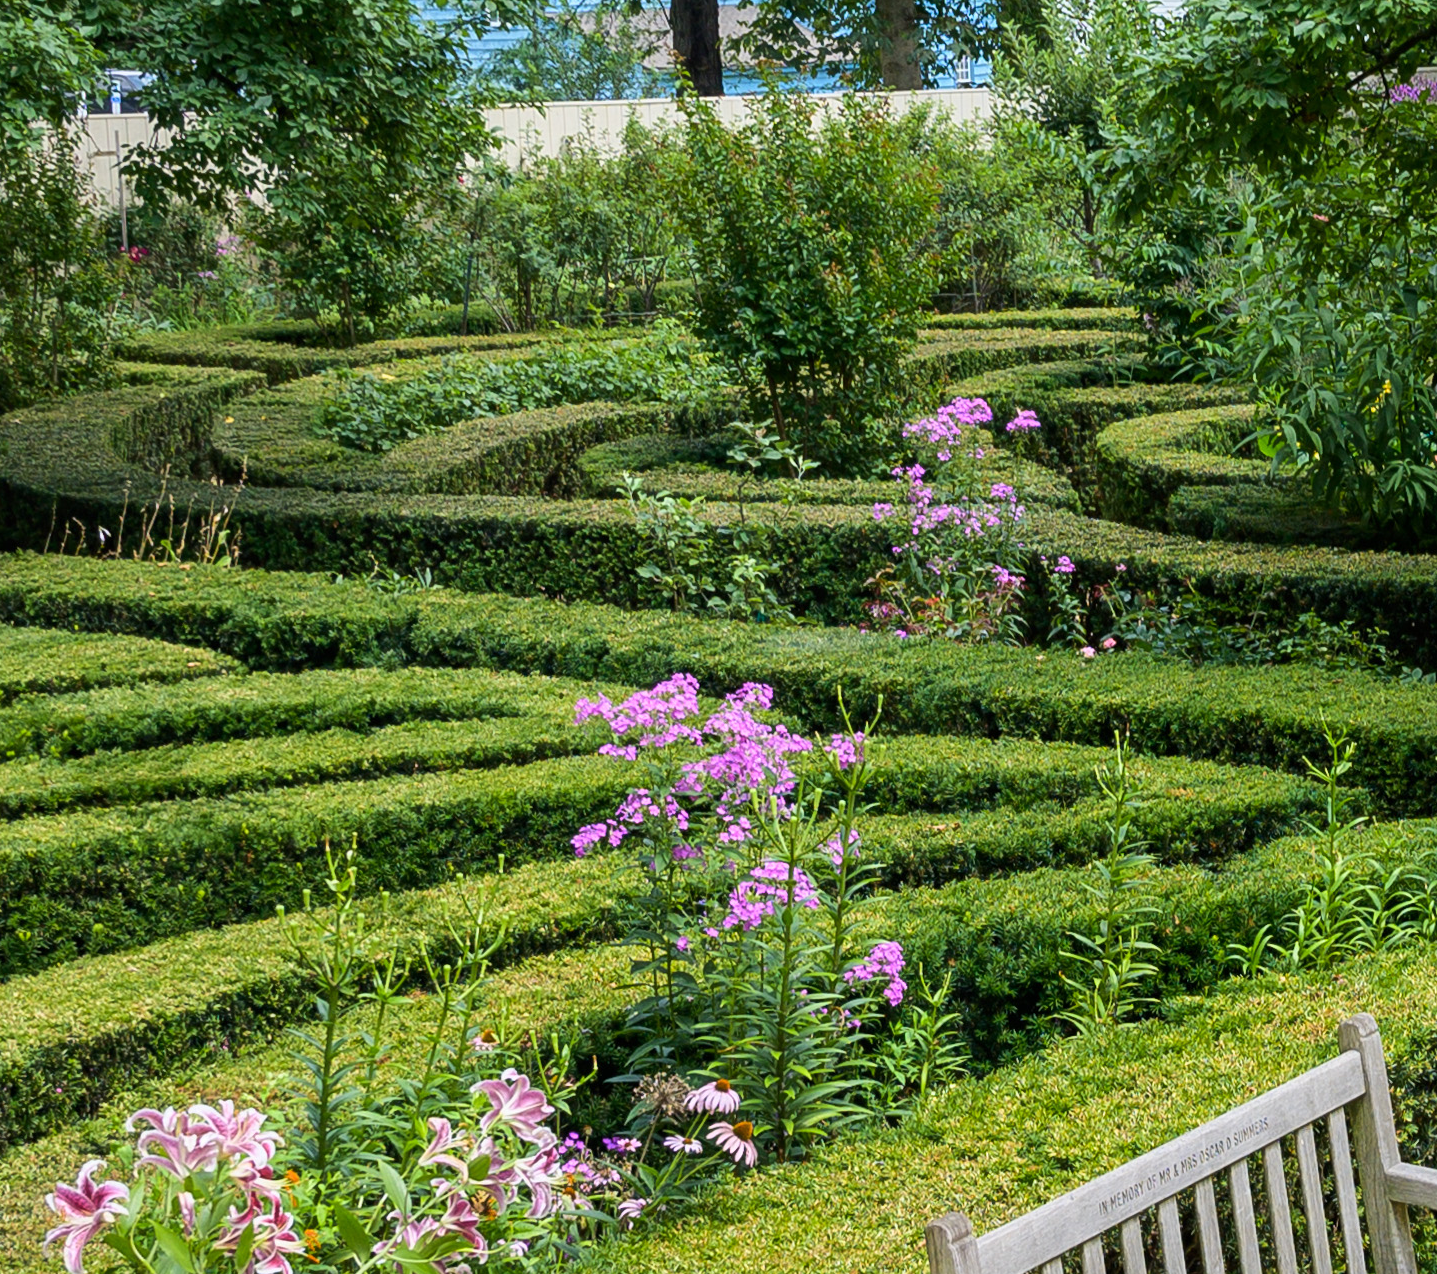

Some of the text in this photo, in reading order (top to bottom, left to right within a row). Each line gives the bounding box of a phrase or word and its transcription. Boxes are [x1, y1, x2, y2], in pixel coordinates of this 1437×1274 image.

[1098, 1200, 1108, 1216] IN
[1110, 1182, 1144, 1211] MEMORY
[1146, 1176, 1156, 1192] OF
[1158, 1167, 1172, 1184] MR
[1173, 1164, 1179, 1178] &
[1180, 1154, 1198, 1174] MRS
[1199, 1140, 1225, 1164] OSCAR
